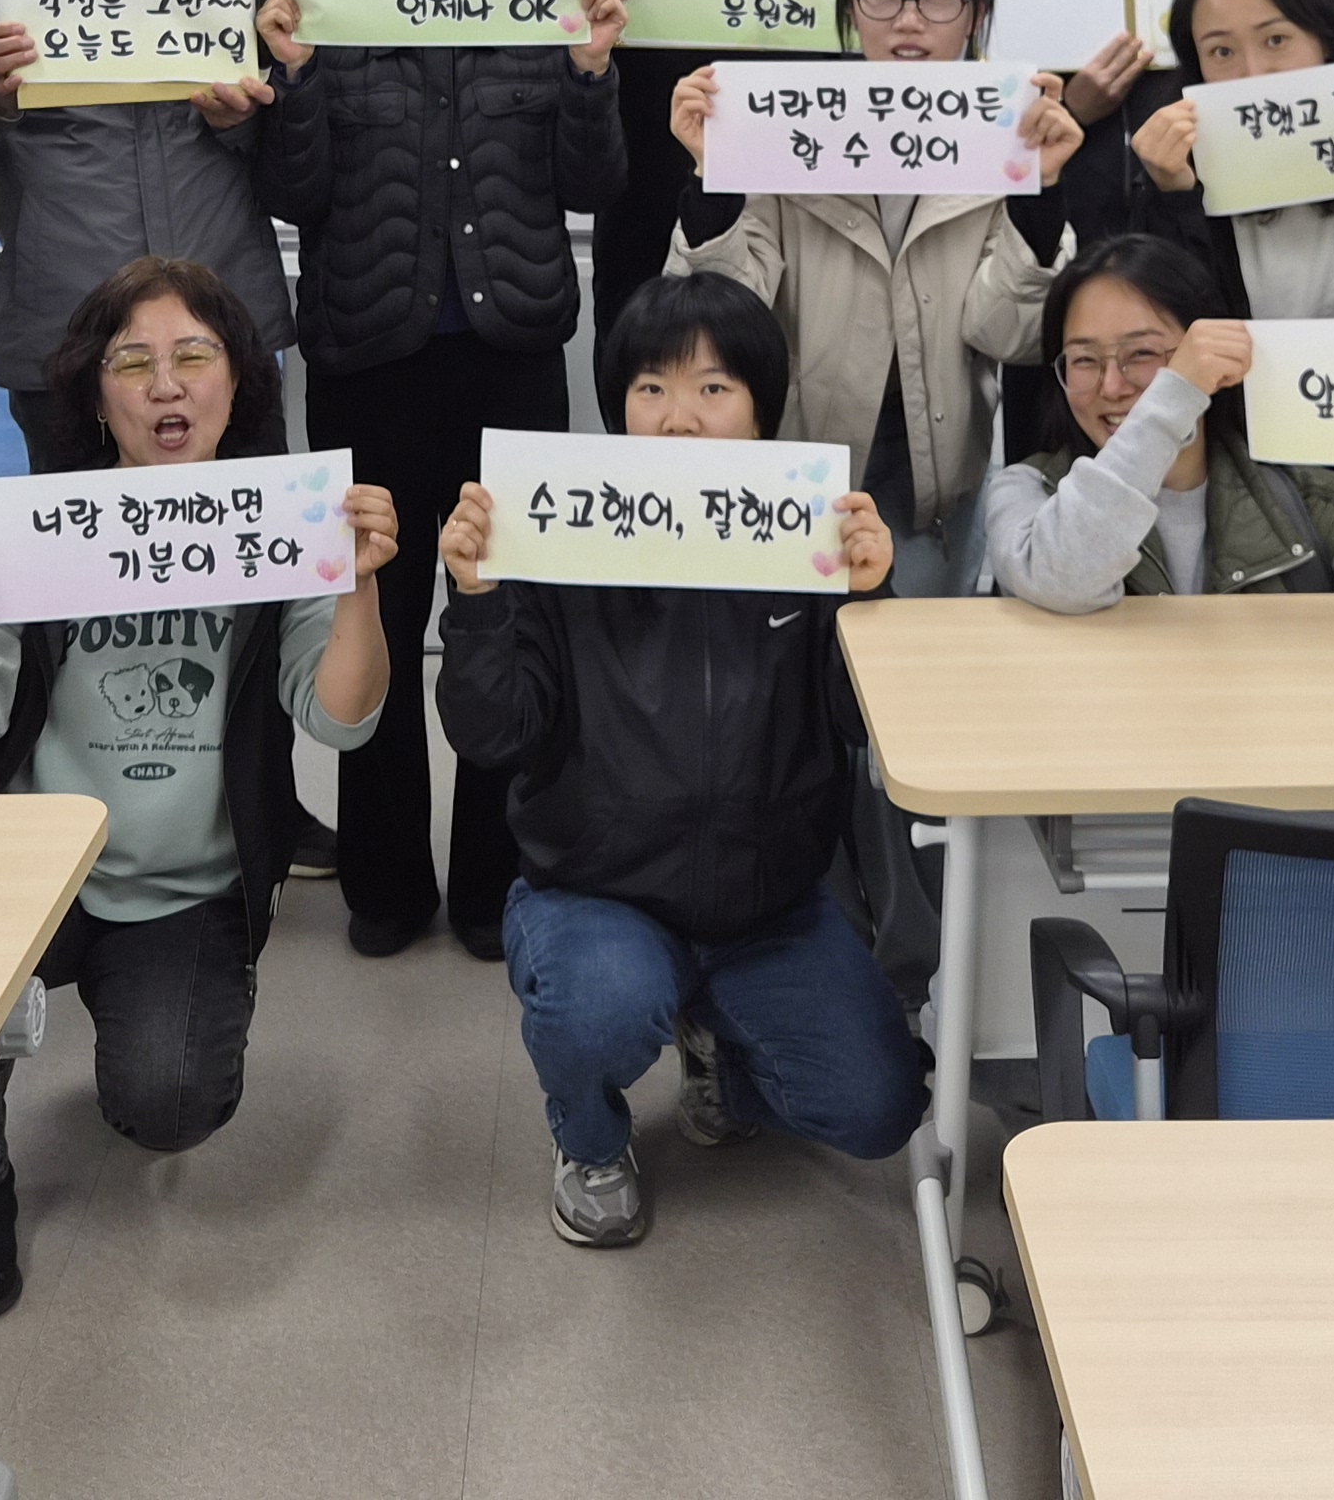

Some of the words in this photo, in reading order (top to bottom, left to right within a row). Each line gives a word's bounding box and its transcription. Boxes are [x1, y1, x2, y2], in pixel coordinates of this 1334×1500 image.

[43, 24, 135, 62] 오늘도
[155, 26, 246, 65] 스마일
[748, 86, 847, 122] 너라면
[867, 85, 1003, 124] 무엇이든
[1233, 98, 1321, 140] 잘했고
[789, 128, 824, 171] 할
[842, 131, 871, 169] 수
[889, 130, 959, 170] 있어
[32, 498, 104, 540] 너랑
[118, 487, 263, 536] 함께하면
[527, 480, 684, 540] 수고했어,
[699, 486, 812, 543] 잘했어
[108, 541, 216, 584] 기분이
[234, 531, 304, 579] 좋아
[129, 765, 170, 778] CHASE
